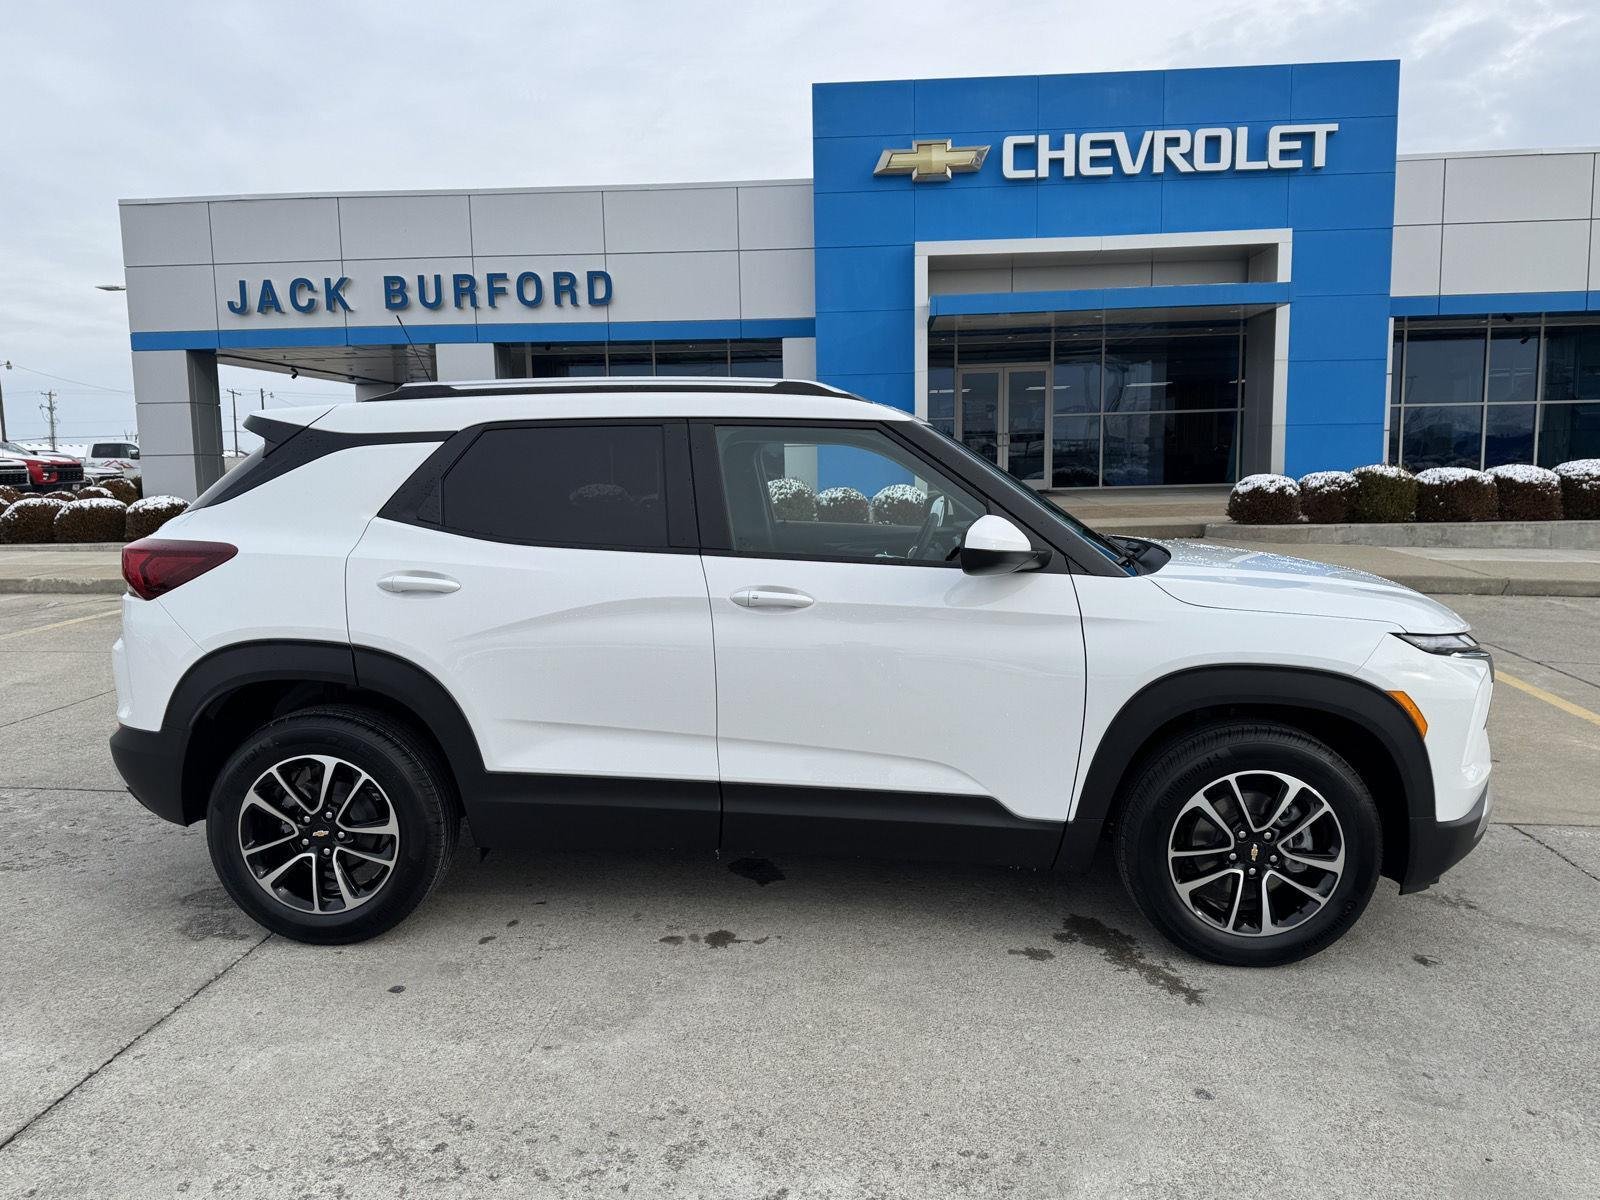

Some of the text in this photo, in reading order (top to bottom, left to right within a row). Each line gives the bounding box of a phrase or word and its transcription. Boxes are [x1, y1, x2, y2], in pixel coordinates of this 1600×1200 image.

[1002, 123, 1339, 180] CHEVROLET
[227, 270, 613, 315] JACK BURFORD
